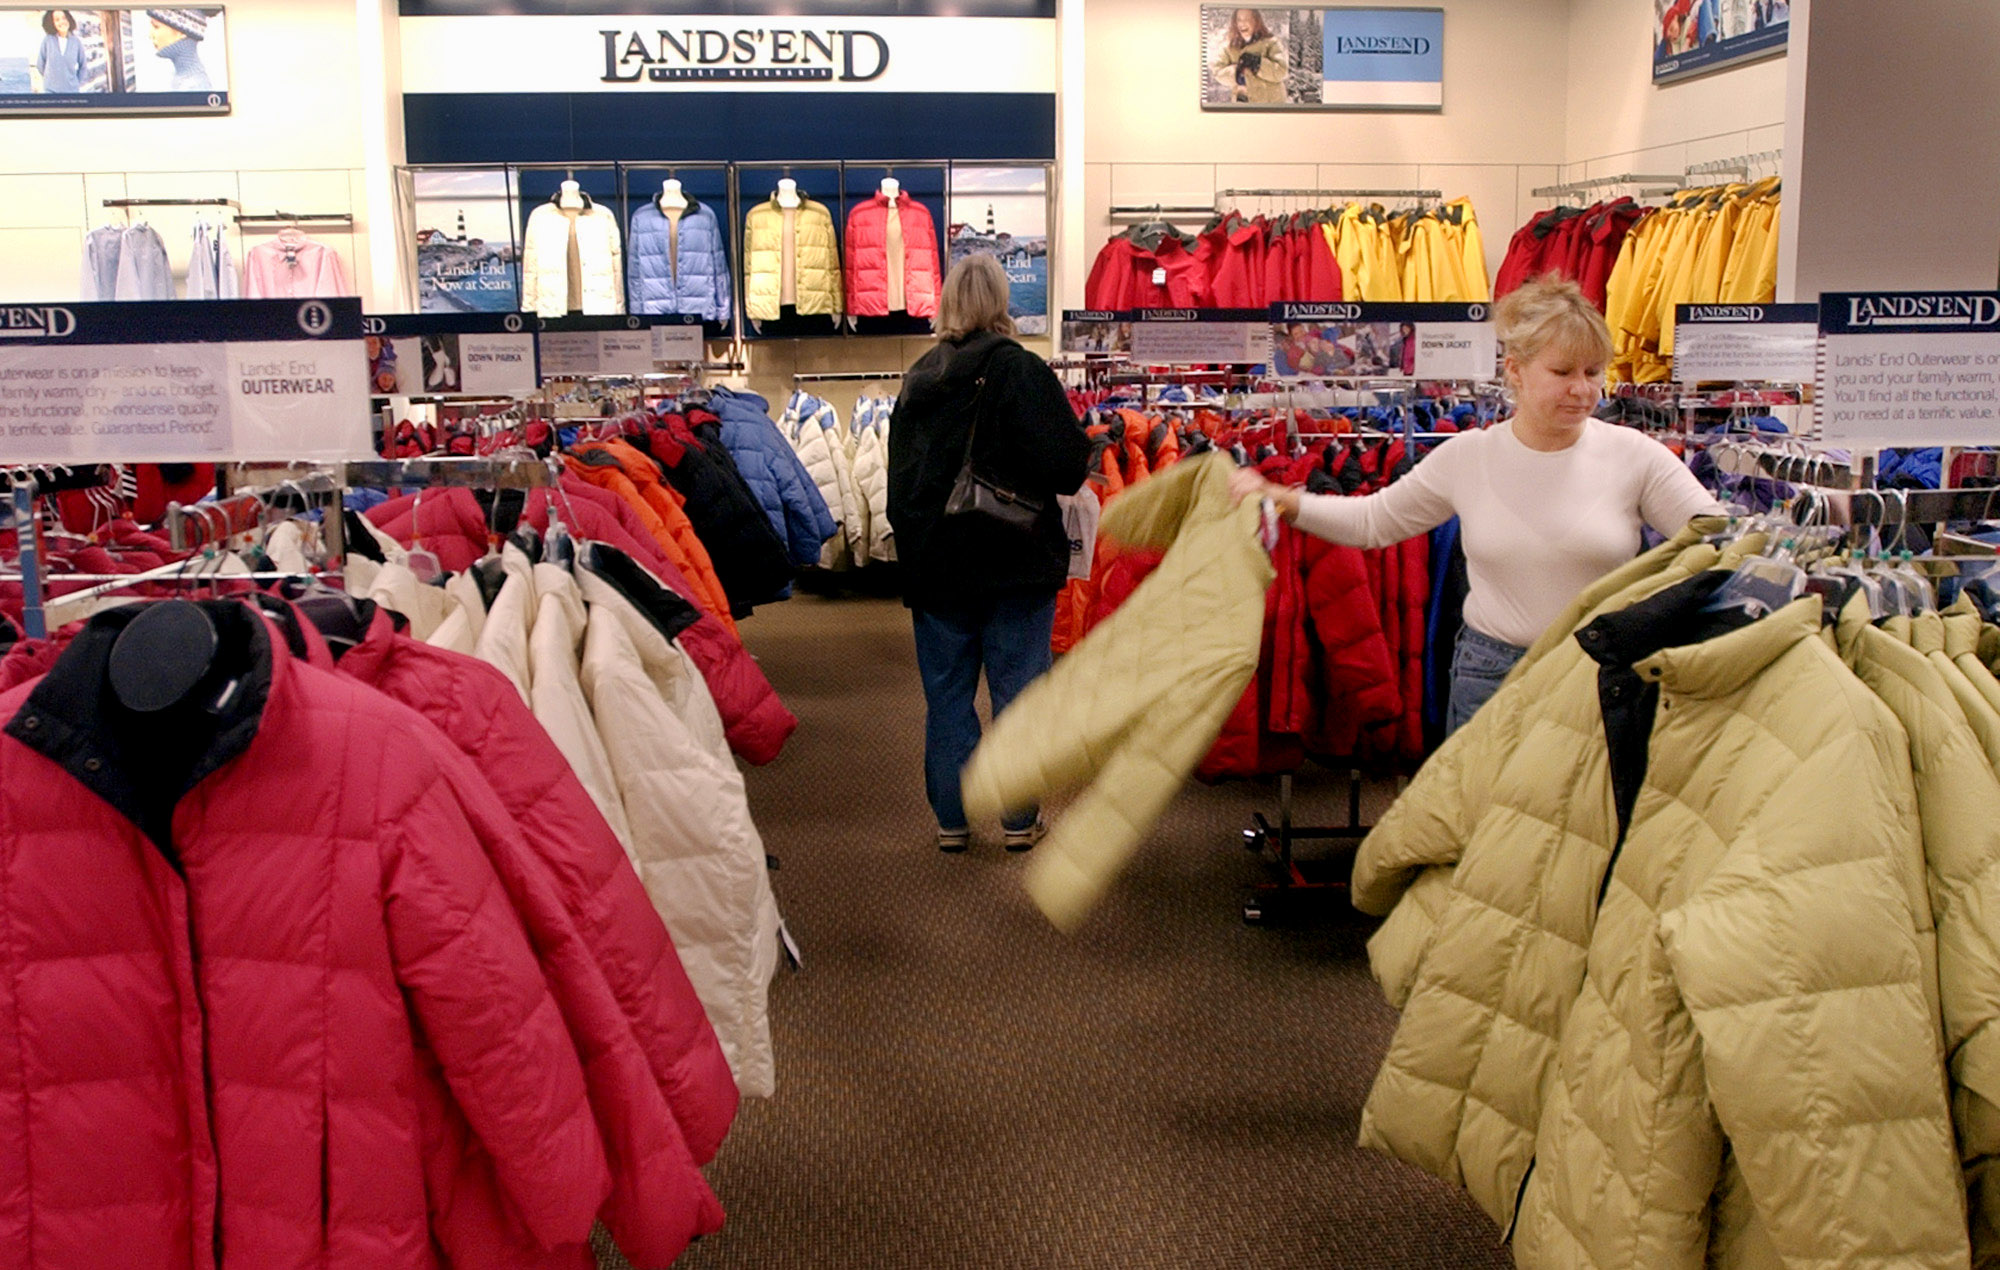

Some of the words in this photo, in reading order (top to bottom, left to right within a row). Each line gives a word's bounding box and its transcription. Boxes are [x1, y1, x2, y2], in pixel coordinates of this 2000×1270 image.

[1336, 36, 1430, 55] LANDS'END
[598, 28, 890, 82] LANDS'END
[480, 261, 506, 275] End
[431, 276, 462, 291] Now
[464, 281, 478, 290] at
[478, 276, 513, 290] Sears
[1283, 303, 1362, 320] LANDS'END
[1688, 305, 1764, 322] LANDS'END
[1847, 296, 2000, 326] LANDS'END
[1421, 340, 1444, 349] DOWN
[1446, 340, 1472, 349] JACKET
[1836, 353, 1877, 367] Lands'
[1880, 352, 1905, 367] End
[1907, 352, 1972, 366] Outerwear
[1974, 353, 1985, 366] is
[58, 367, 69, 379] is
[71, 367, 89, 379] on
[91, 367, 100, 379] a
[239, 361, 286, 376] Lands'
[288, 361, 317, 376] End
[241, 378, 335, 395] OUTERWEAR
[1833, 374, 1857, 388] you
[1859, 372, 1884, 385] and
[1886, 373, 1914, 387] your
[1918, 370, 1954, 387] family
[1957, 372, 1996, 385] warm,
[1834, 389, 1866, 403] You'll
[1868, 388, 1892, 403] find
[1895, 389, 1909, 402] all
[1911, 389, 1932, 402] the
[1935, 388, 1999, 403] functional,
[1832, 410, 1855, 424] you
[1858, 407, 1889, 421] need
[1893, 408, 1905, 420] at
[1906, 408, 1916, 420] a
[1918, 406, 1956, 420] terrific
[1959, 406, 1995, 419] value.
